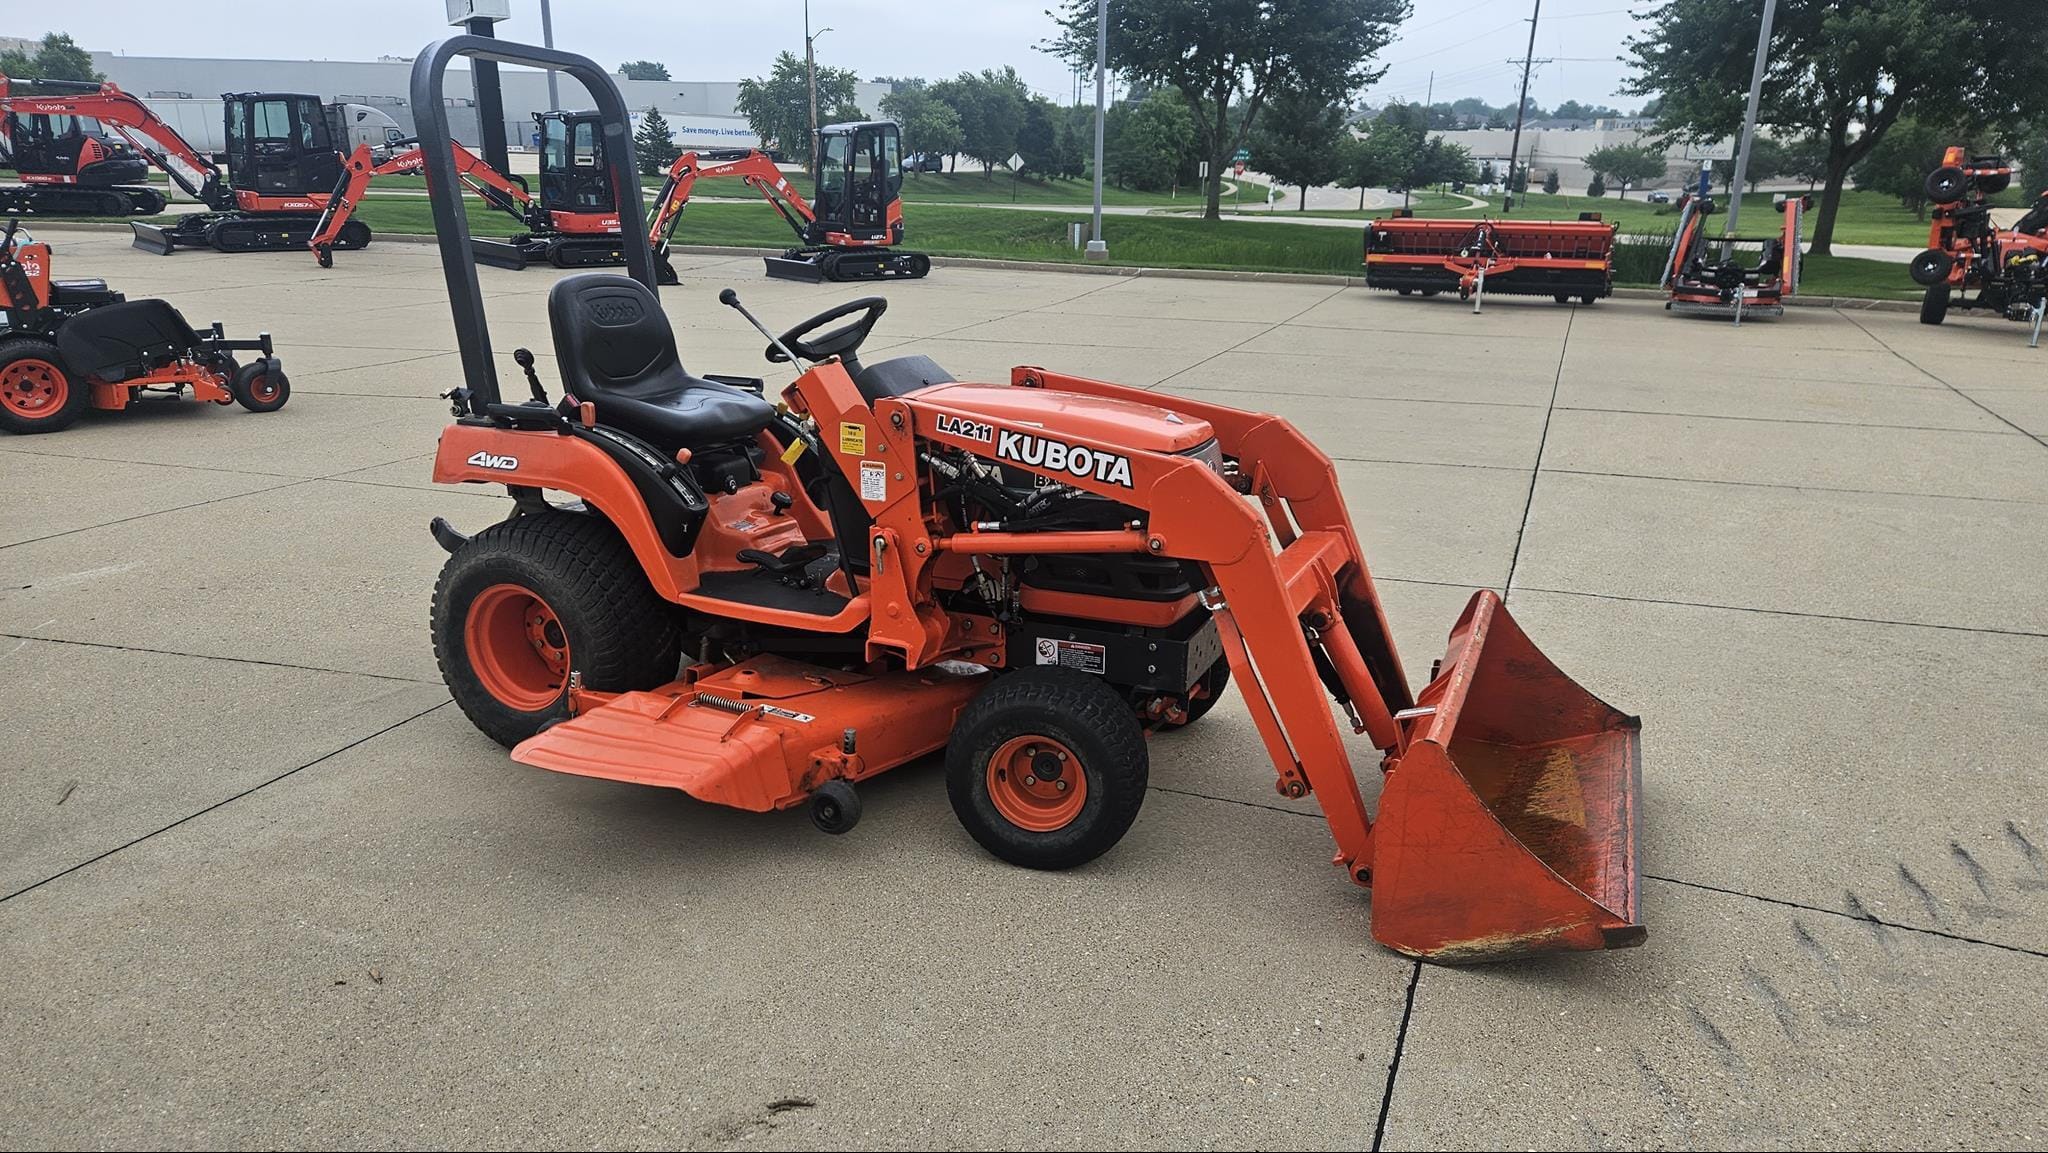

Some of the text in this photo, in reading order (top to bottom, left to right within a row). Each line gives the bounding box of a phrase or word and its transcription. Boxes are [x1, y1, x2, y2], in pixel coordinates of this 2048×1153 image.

[682, 126, 697, 134] Save
[697, 127, 721, 136] money.
[721, 128, 734, 136] Live
[938, 415, 992, 442] LA211
[467, 451, 518, 470] 4WD
[998, 431, 1132, 487] KUBOTA
